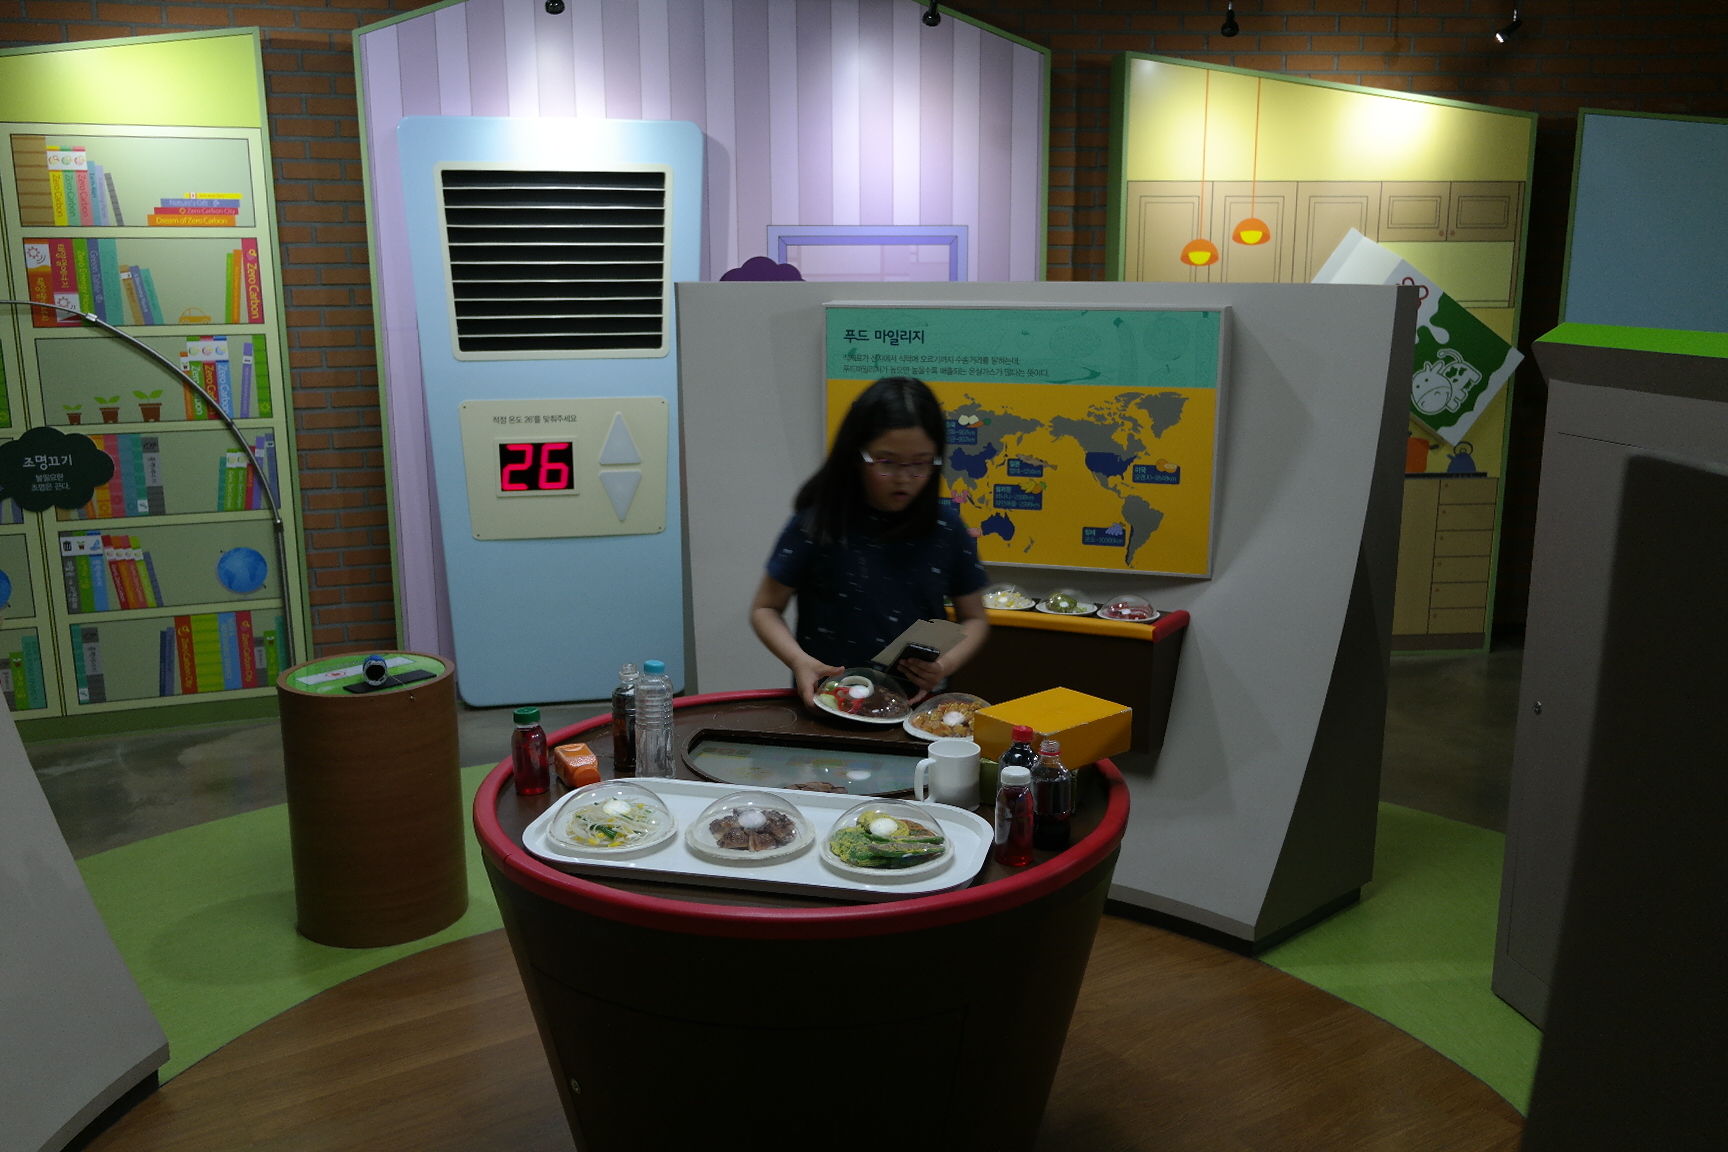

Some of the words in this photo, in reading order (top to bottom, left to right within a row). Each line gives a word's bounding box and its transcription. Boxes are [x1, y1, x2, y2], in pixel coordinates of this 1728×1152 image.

[52, 174, 60, 191] Zero
[65, 174, 74, 191] Zero
[78, 174, 86, 191] Zero
[54, 191, 64, 218] Carbon
[67, 191, 76, 218] Carbon
[80, 191, 89, 218] Carbon
[56, 244, 70, 288] 태양열에너지
[77, 250, 86, 268] Zero
[90, 250, 99, 274] Green
[79, 268, 88, 294] Energy
[92, 274, 102, 293] Table
[247, 263, 257, 284] Zero
[34, 277, 49, 322] 태양광너지
[249, 285, 260, 320] Carbon
[844, 329, 870, 344] 푸드
[874, 329, 924, 346] 마일리지
[204, 365, 214, 384] Zero
[218, 364, 226, 384] Zero
[844, 364, 888, 373] 푸드마일리지가
[492, 416, 507, 425] 적정
[508, 416, 523, 424] 온도
[542, 414, 577, 423] 맞춰주세요
[22, 454, 73, 471] 조명끄기
[502, 442, 569, 491] 26
[183, 653, 192, 675] Carbon
[244, 648, 252, 670] Carbon
[185, 676, 193, 688] City
